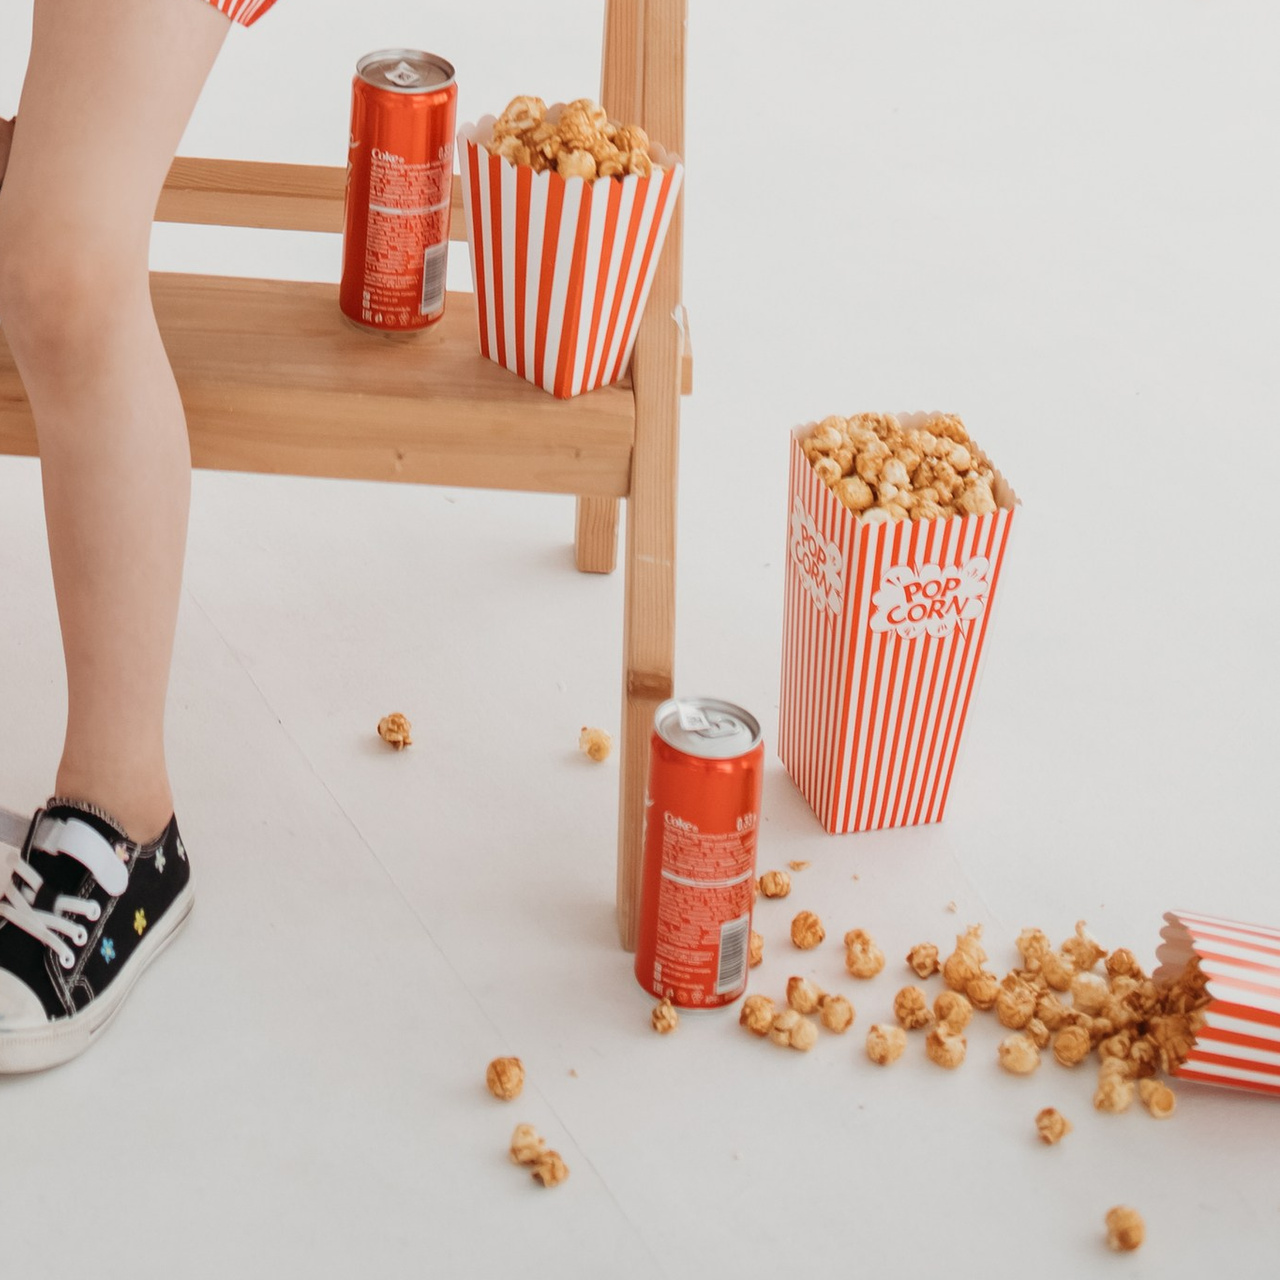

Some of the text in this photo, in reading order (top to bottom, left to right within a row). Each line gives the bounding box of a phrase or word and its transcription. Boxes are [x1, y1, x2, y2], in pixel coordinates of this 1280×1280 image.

[801, 523, 827, 565] POP
[795, 540, 832, 597] CORN
[902, 577, 961, 604] POP
[886, 595, 969, 625] CORN
